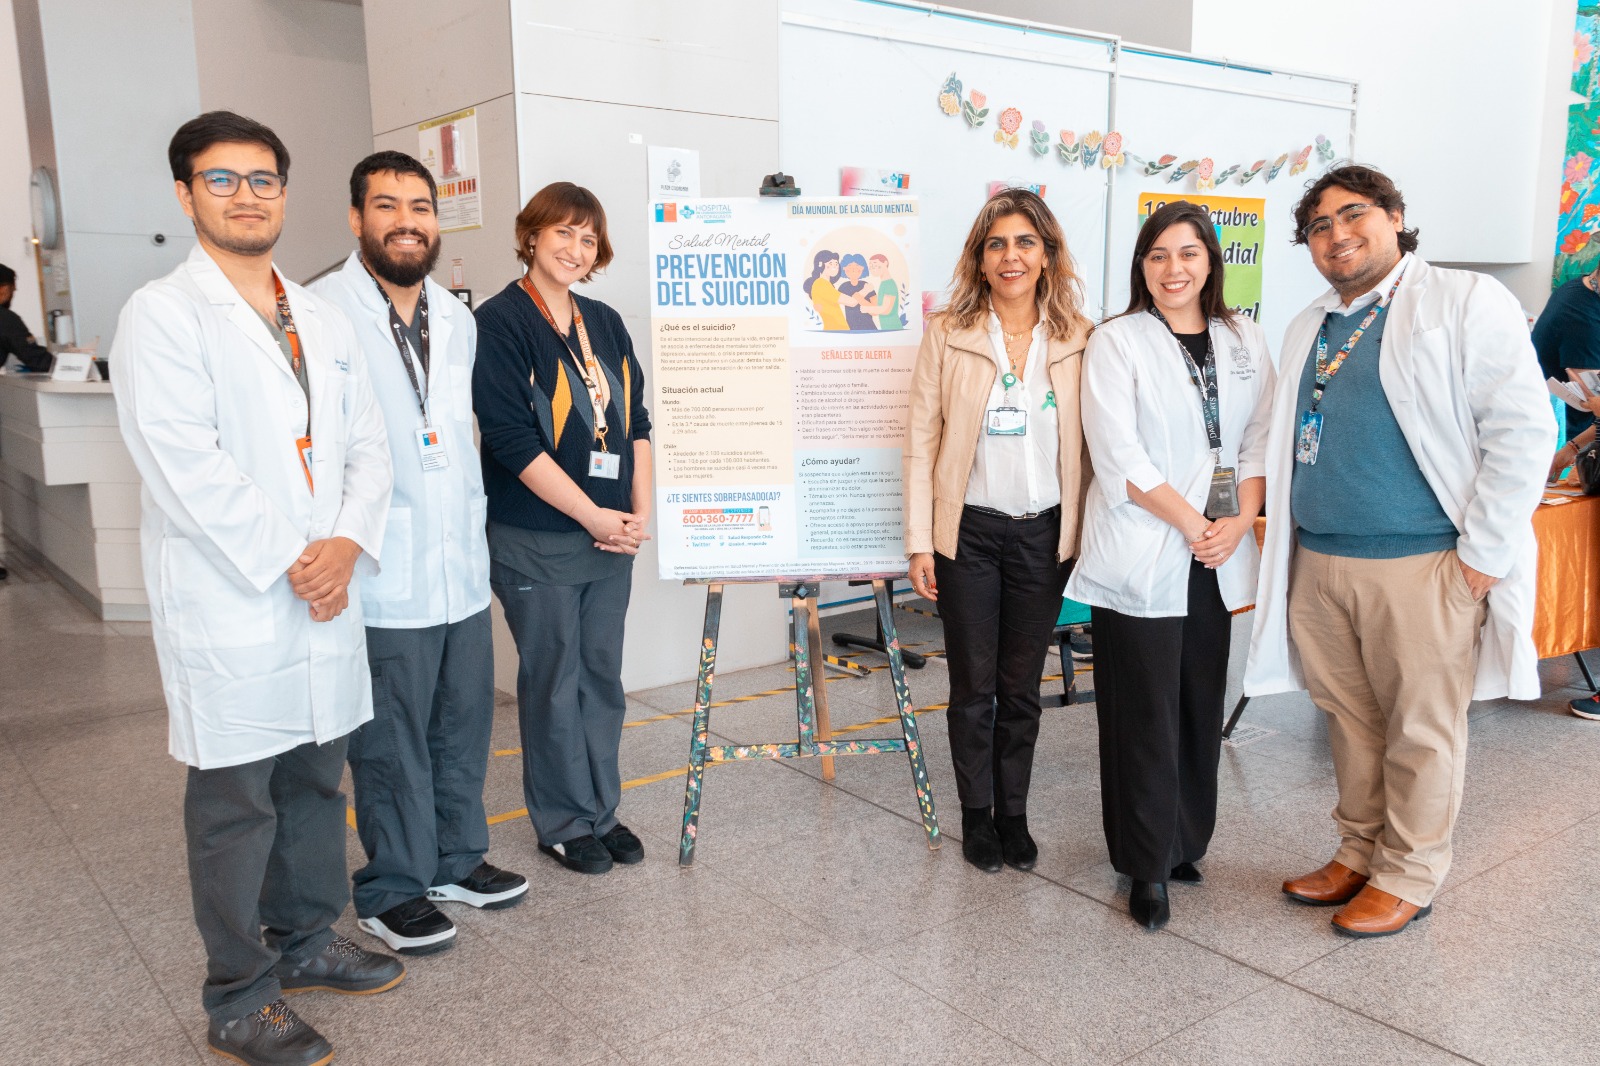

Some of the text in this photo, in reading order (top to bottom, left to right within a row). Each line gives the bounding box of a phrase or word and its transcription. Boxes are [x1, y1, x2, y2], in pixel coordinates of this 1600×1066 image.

[792, 204, 913, 215] DÍA MUNDIAL DE LA SALUD MENTAL
[668, 233, 771, 250] Salud Mental
[656, 248, 786, 279] PREVENCIÓN
[657, 280, 790, 306] DEL SUICIDIO
[660, 324, 679, 332] ¿Qué
[822, 350, 892, 360] SEÑALES DE ALERTA
[802, 458, 828, 467] ¿Cómo
[667, 492, 781, 503] ¿TE SIENTES SOBREPASADO(A)?
